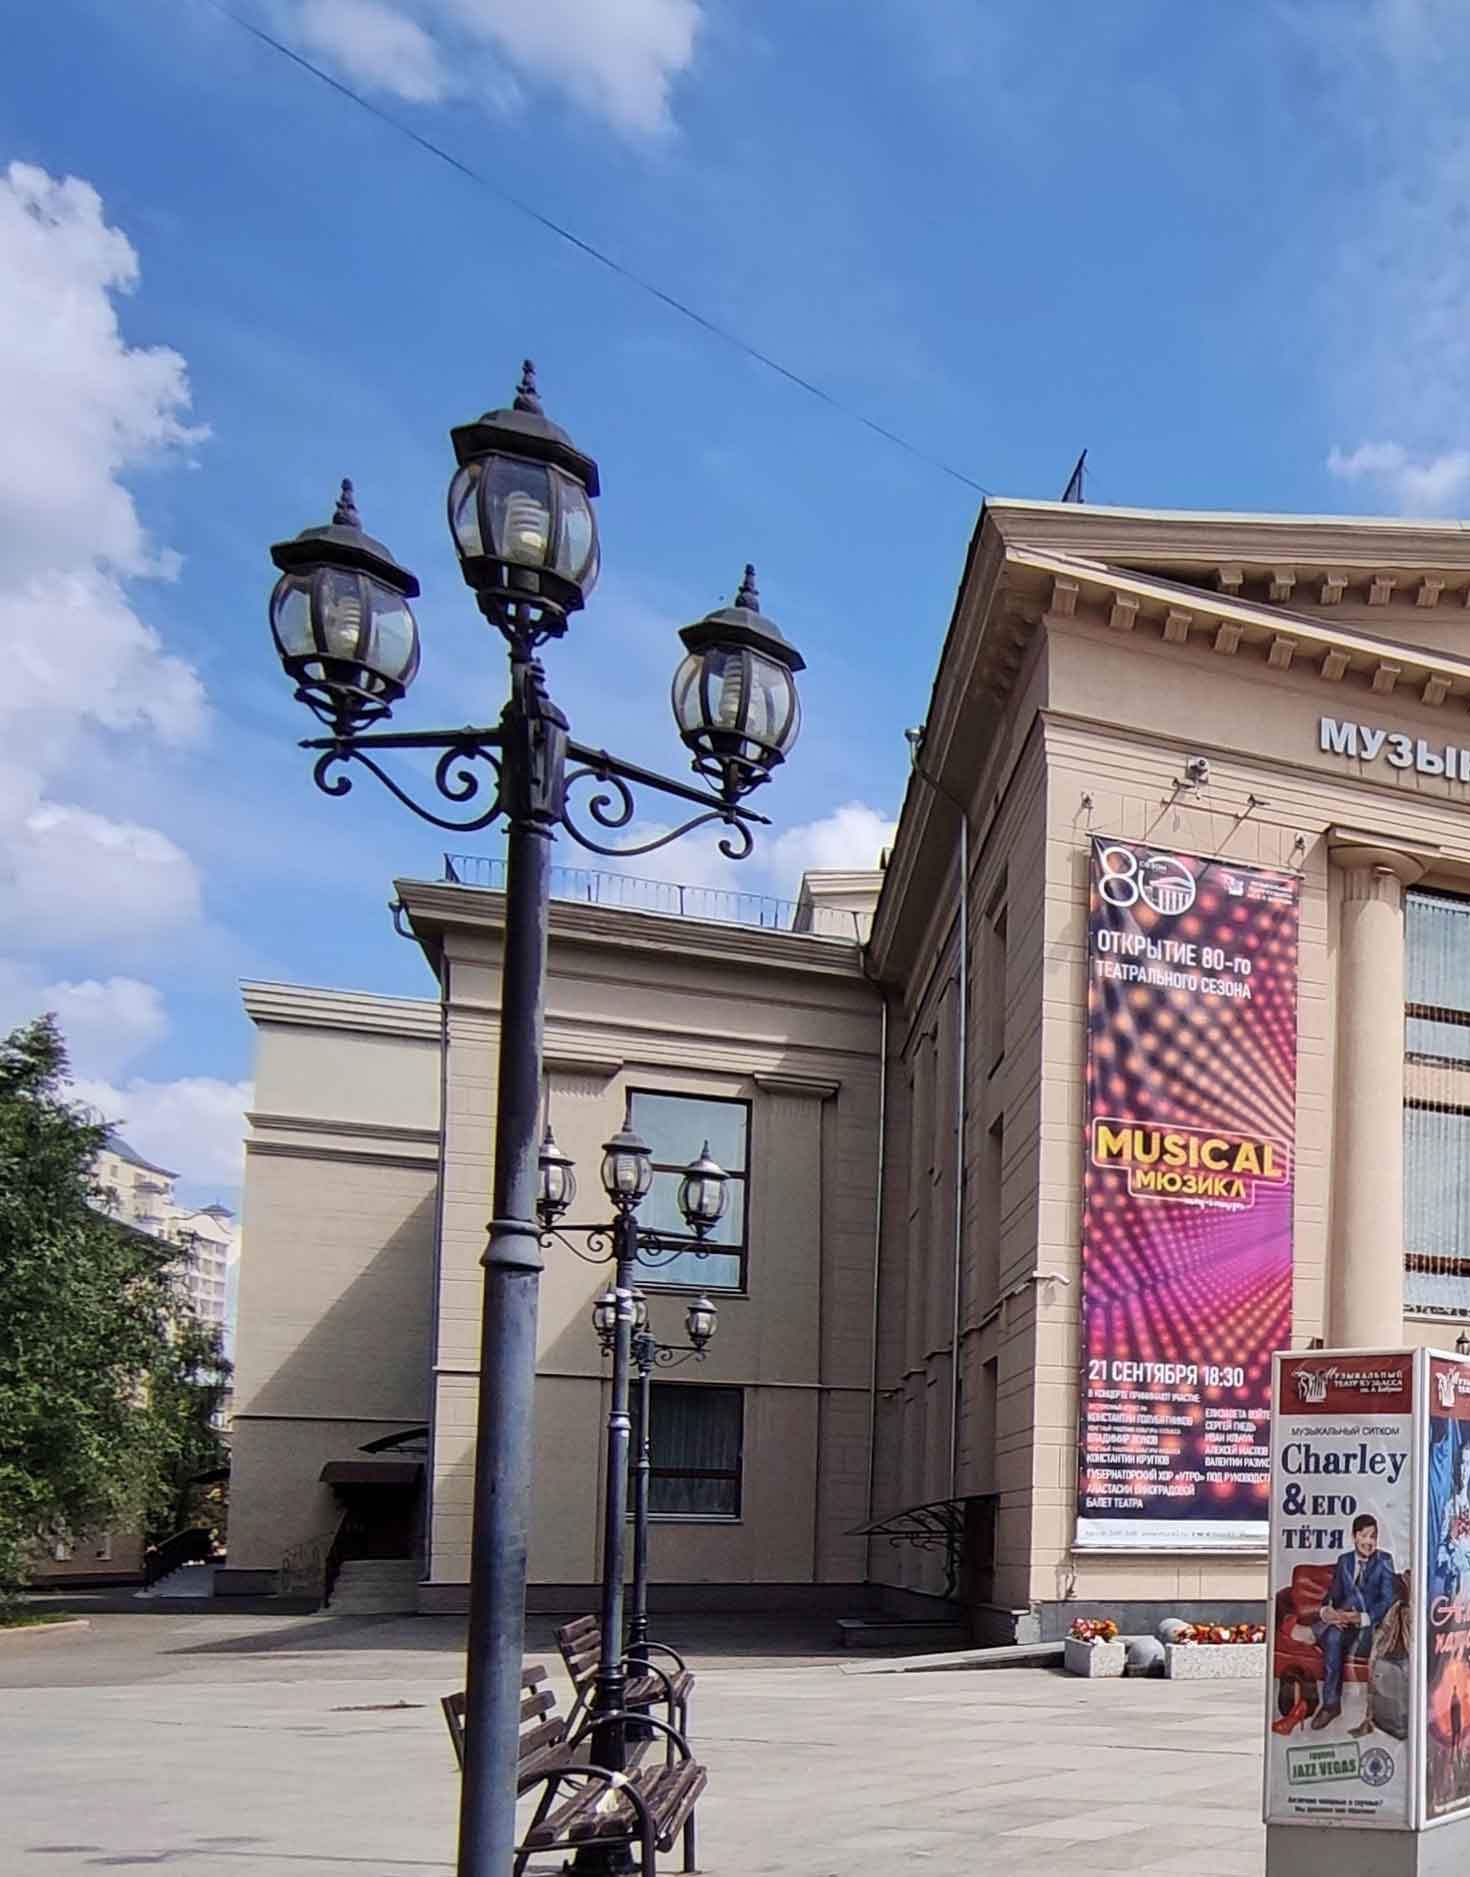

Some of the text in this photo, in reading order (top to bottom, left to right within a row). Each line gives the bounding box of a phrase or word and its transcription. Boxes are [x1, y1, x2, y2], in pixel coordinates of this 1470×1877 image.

[1097, 929, 1251, 975] ОТКРЫТИЕ 80-го
[1096, 960, 1252, 1000] ТЕАТРАЛЬНОГО СЕЗОНА
[1097, 1126, 1283, 1177] MUSICAL
[1134, 1169, 1246, 1198] МЮЗИКЛ
[1089, 1360, 1244, 1387] 21 СЕНТЯБРЯ 18:30
[1291, 1425, 1399, 1436] МУЗЫКАЛЬНЫЙ СИТКОМ
[1281, 1443, 1407, 1483] Charley
[1282, 1483, 1307, 1516] &
[1319, 1759, 1357, 1776] VEGAS
